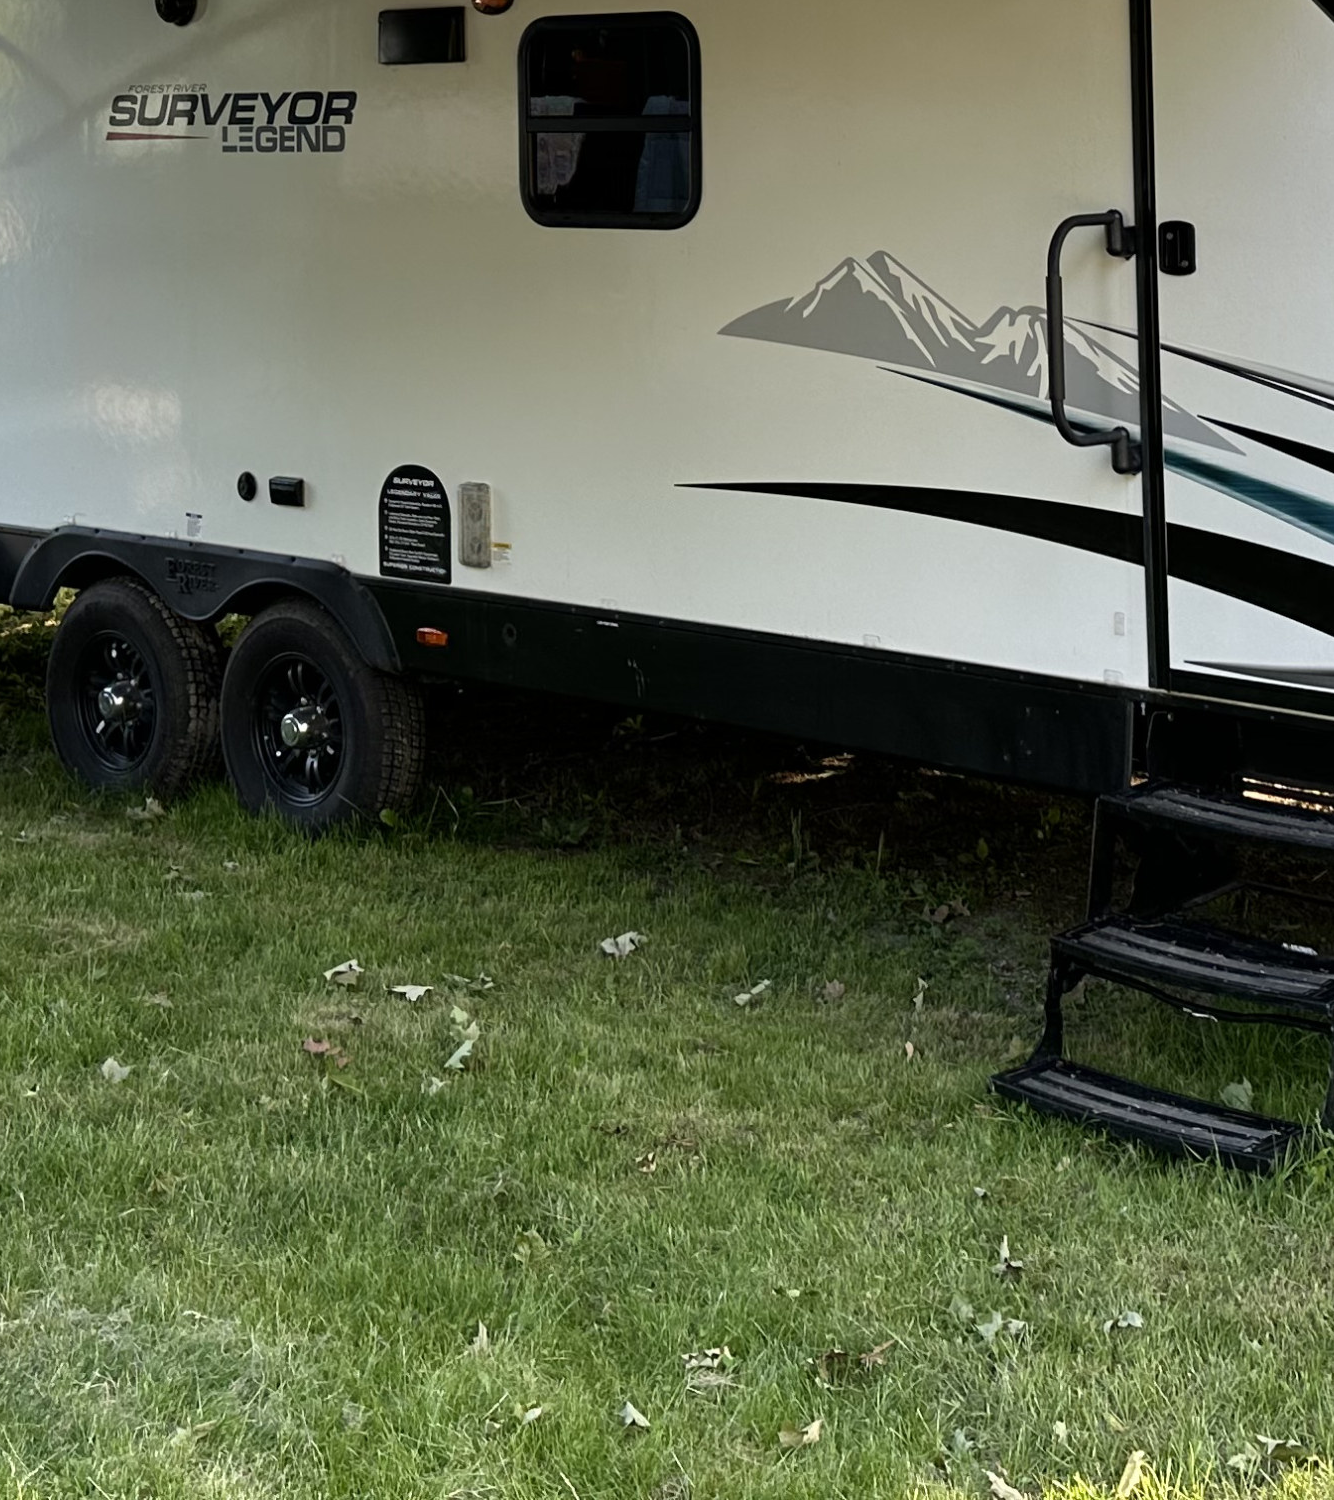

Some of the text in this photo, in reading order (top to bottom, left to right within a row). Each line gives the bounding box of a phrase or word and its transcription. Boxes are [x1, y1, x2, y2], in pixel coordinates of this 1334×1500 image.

[128, 84, 207, 93] FOREST RIVER
[108, 91, 357, 126] SURVEYOR
[222, 125, 345, 152] LEGEND
[393, 477, 434, 487] SURVEYOR
